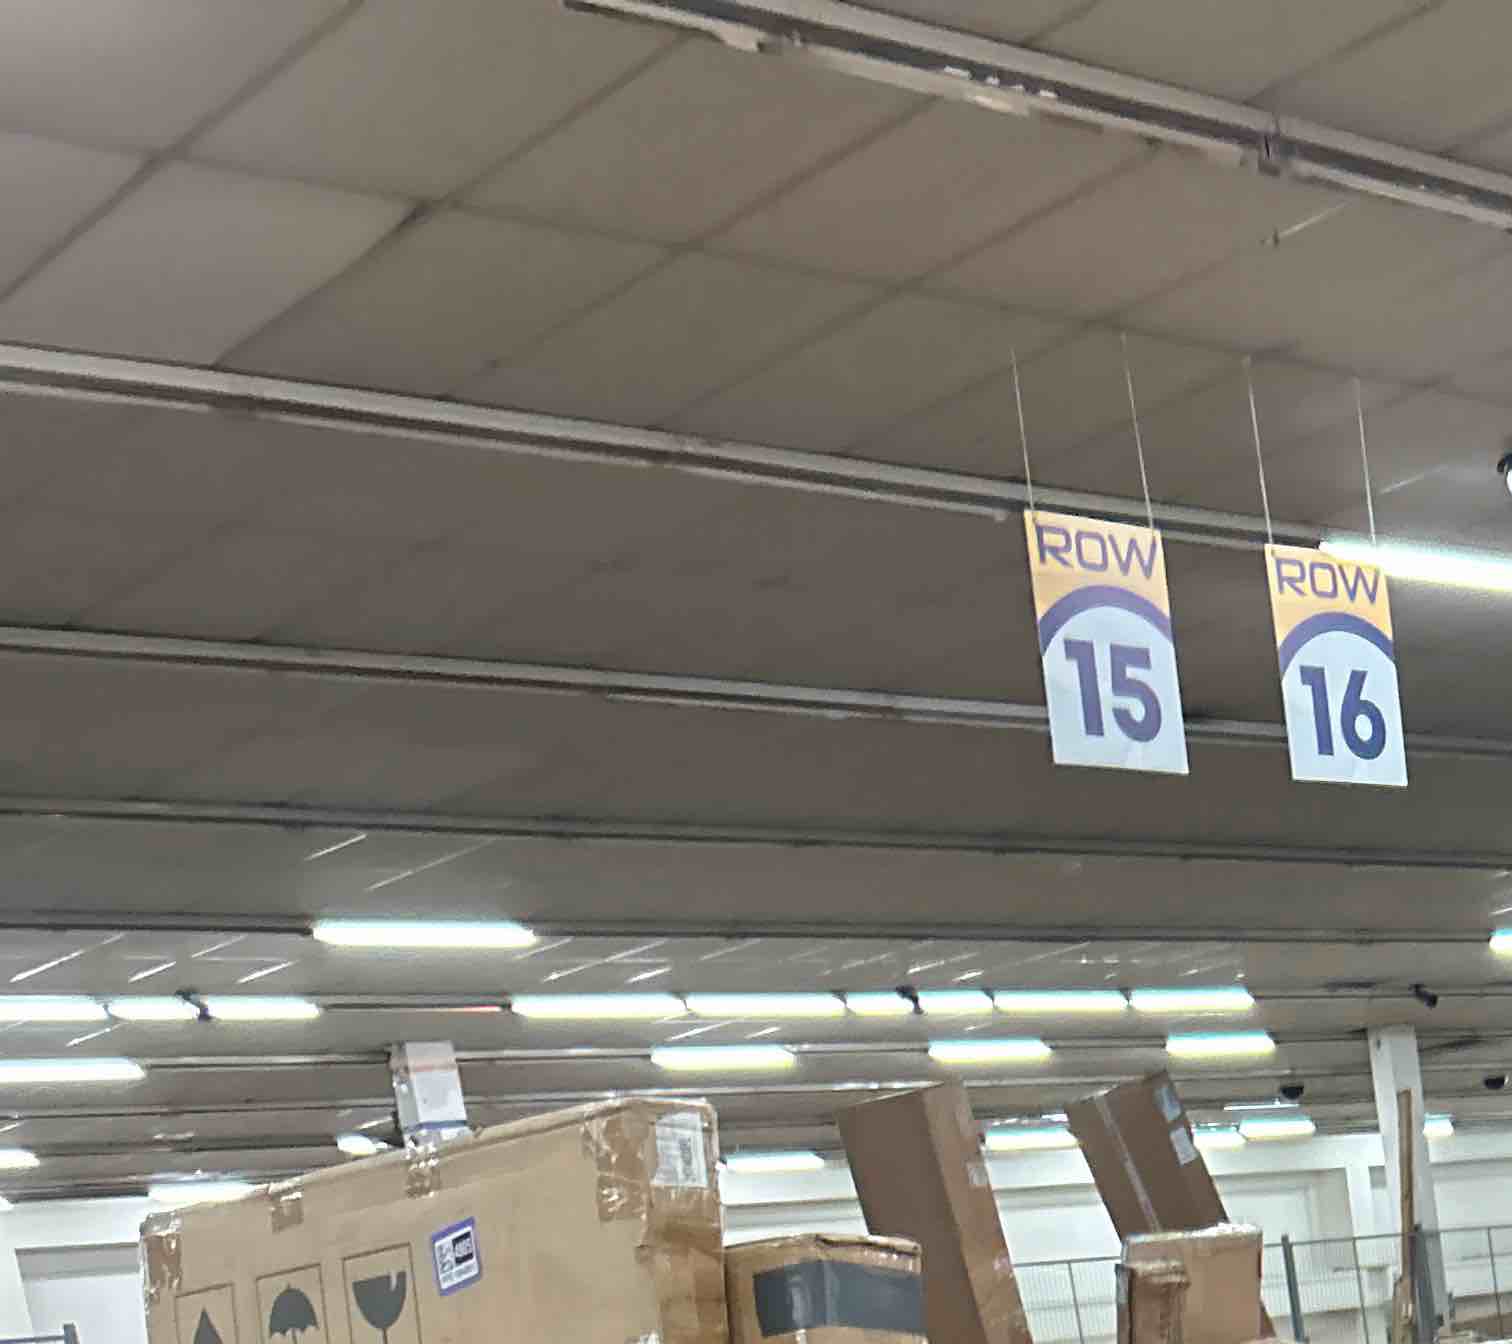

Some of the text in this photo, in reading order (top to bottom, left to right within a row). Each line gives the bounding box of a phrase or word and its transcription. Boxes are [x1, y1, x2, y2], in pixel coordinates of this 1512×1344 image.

[1036, 525, 1157, 579] ROW
[1273, 557, 1381, 605] ROW
[1064, 639, 1162, 743] 15
[1300, 665, 1387, 761] 16
